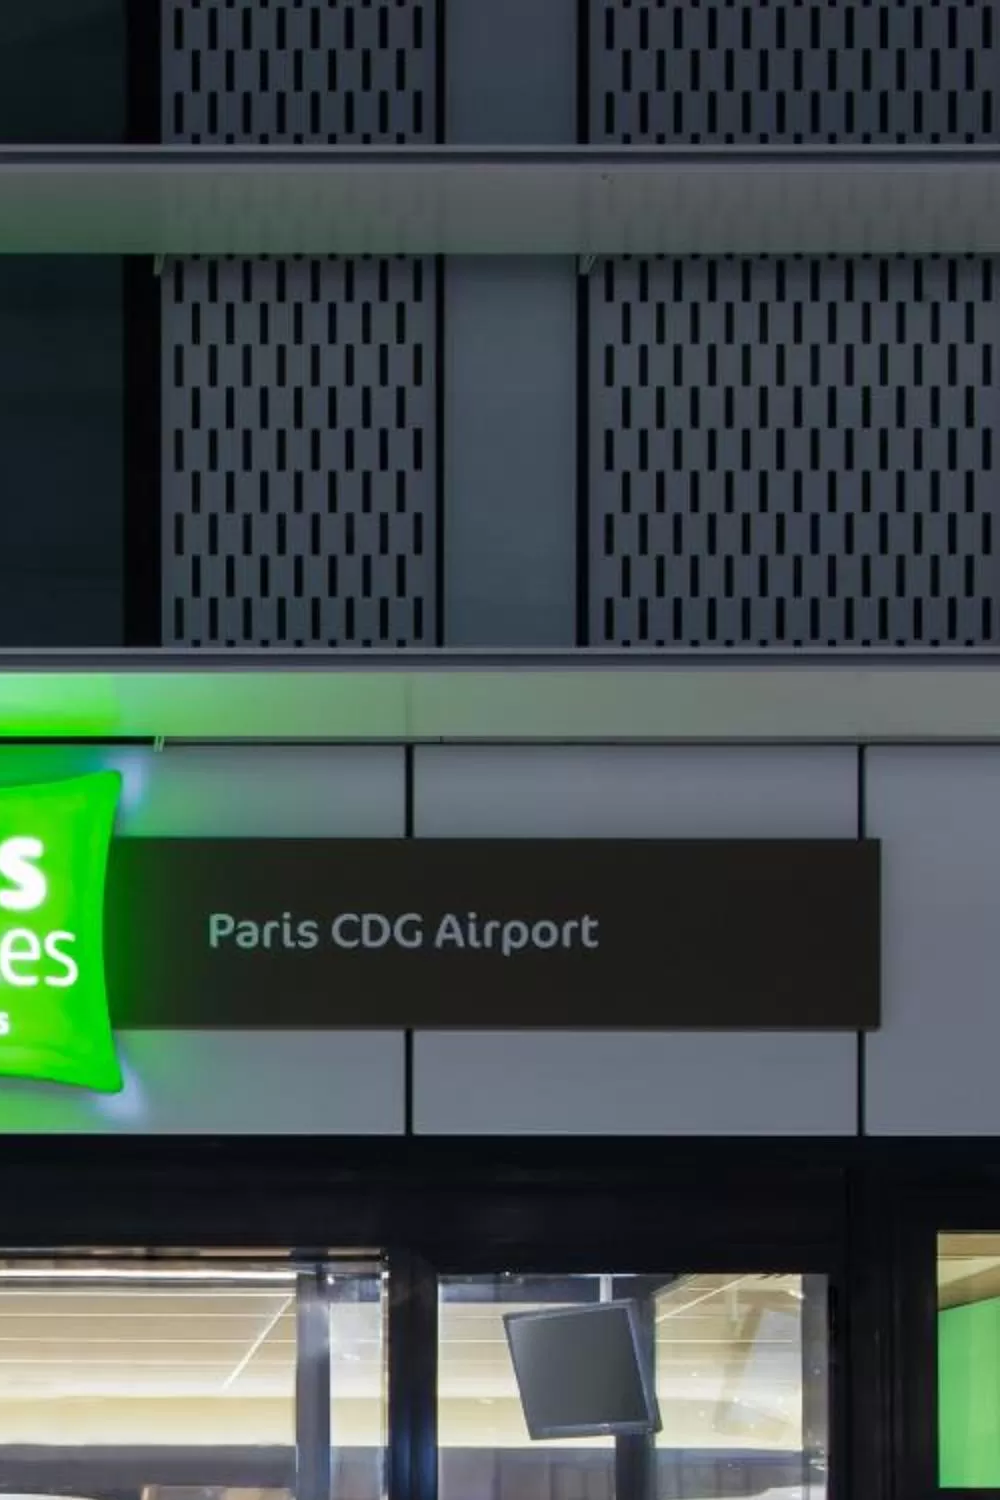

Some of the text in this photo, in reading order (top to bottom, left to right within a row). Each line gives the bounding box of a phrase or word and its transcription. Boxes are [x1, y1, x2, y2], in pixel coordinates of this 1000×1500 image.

[208, 912, 599, 956] Paris CDG Airport
